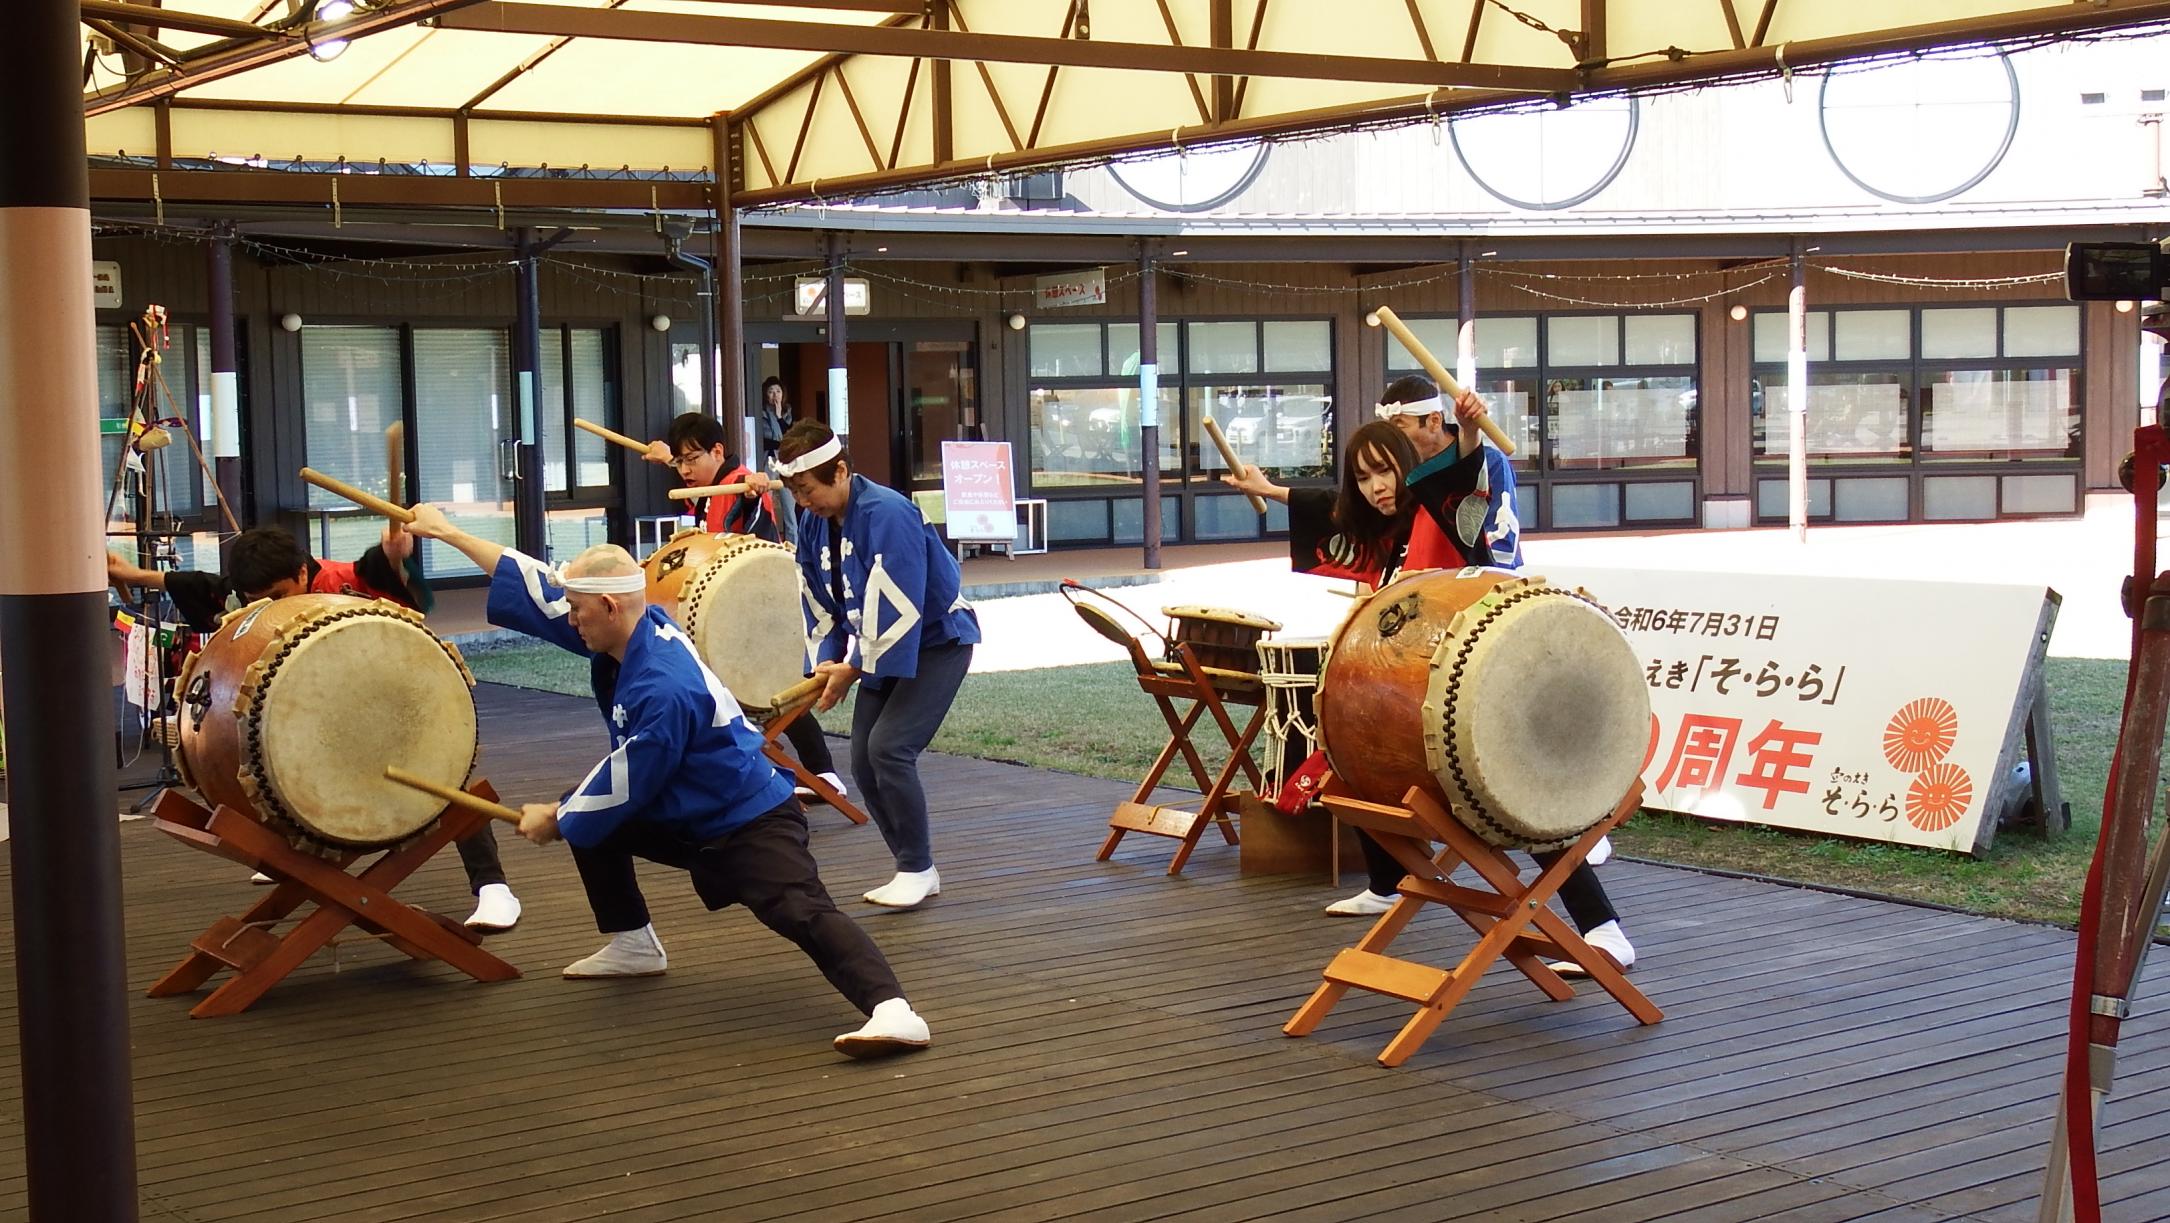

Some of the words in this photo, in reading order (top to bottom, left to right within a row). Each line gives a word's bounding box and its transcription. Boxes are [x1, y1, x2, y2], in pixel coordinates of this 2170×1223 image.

[1646, 654, 1846, 706] えき「そ・ら・ら」
[1830, 766, 1870, 786] 空のえき
[1822, 786, 1899, 823] そ・ら・ら
